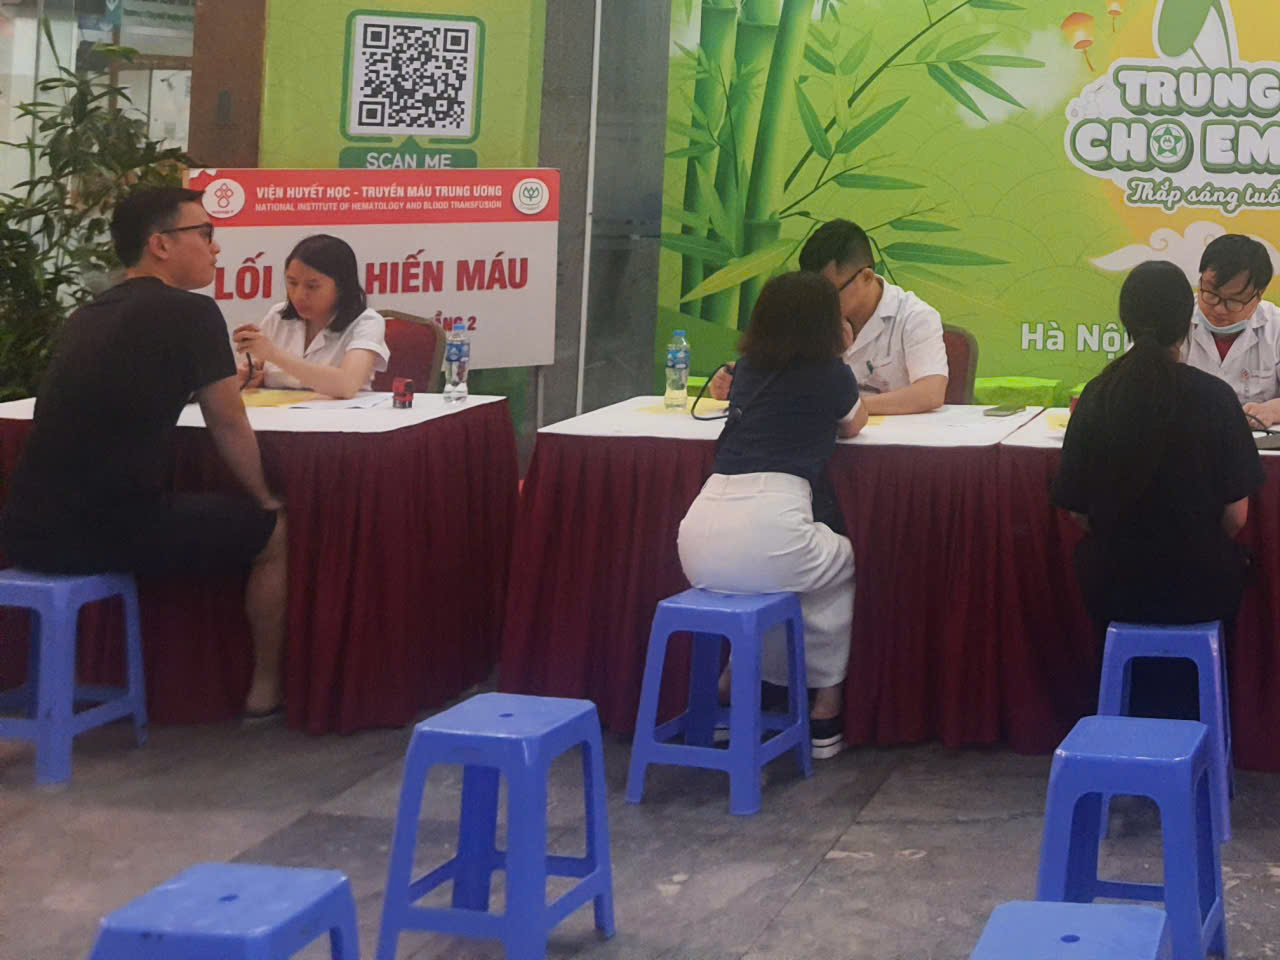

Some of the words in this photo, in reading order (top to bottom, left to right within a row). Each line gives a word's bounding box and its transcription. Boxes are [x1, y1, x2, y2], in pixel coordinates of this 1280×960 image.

[1071, 117, 1194, 173] CHO
[366, 152, 417, 169] SCAN
[424, 153, 452, 169] ME
[256, 184, 284, 201] VIỆN
[287, 182, 323, 199] HUYẾT
[326, 186, 350, 200] HỌC
[435, 185, 470, 197] TRUNG
[1127, 177, 1184, 212] Thắp
[1185, 181, 1241, 213] sáng
[256, 203, 294, 212] NATIONAL
[297, 202, 337, 212] INSTITUTE
[340, 202, 350, 211] OF
[352, 201, 404, 211] HEMATOLOGY
[406, 201, 421, 210] AND
[423, 201, 449, 210] BLOOD
[451, 200, 502, 209] TRANSFUSION
[215, 252, 273, 301] LỐI
[365, 249, 444, 295] HIẾN
[456, 251, 528, 292] MÁU
[467, 315, 478, 331] 2
[1021, 321, 1065, 352] Hà
